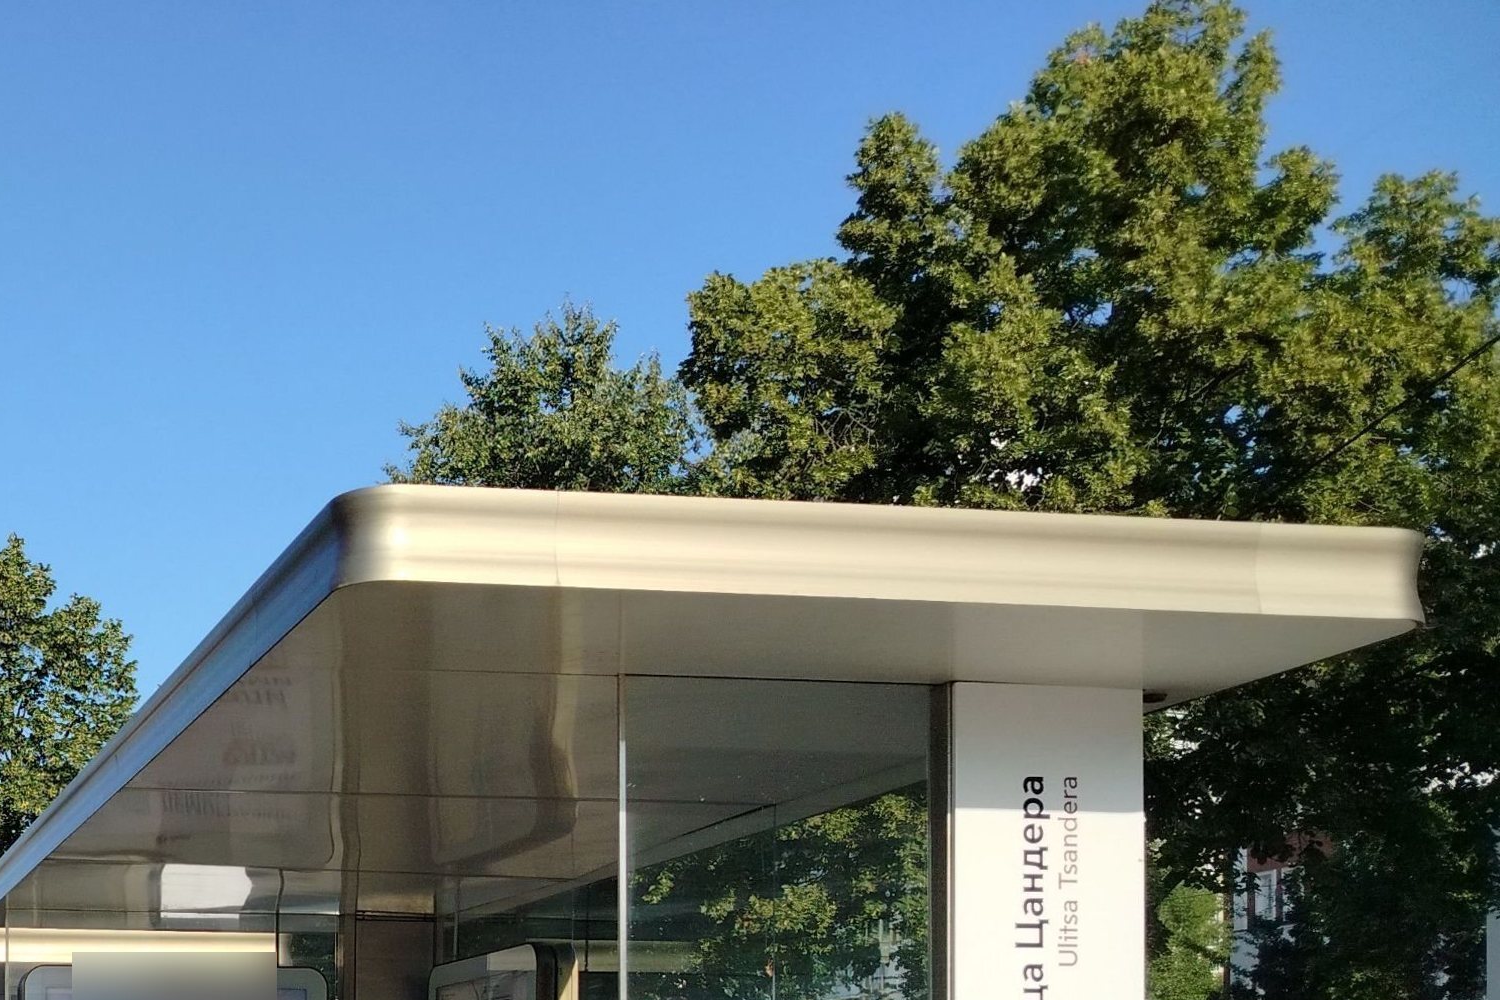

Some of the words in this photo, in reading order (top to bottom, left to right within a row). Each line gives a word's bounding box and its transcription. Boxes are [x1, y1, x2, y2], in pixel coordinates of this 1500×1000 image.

[1014, 775, 1050, 949] Цандера
[1057, 775, 1079, 890] Tsandera
[1057, 899, 1079, 968] Ulitsa
